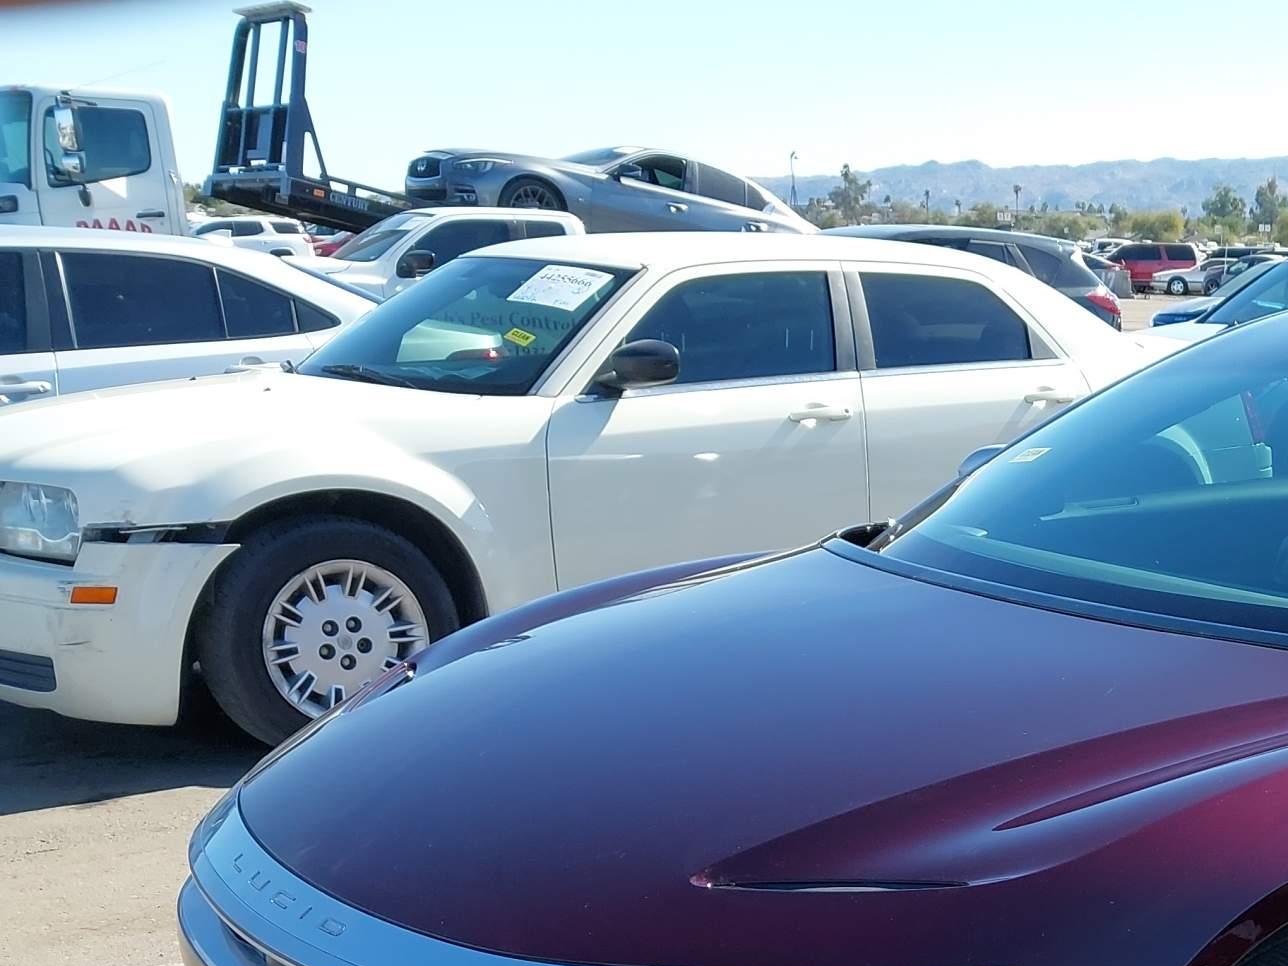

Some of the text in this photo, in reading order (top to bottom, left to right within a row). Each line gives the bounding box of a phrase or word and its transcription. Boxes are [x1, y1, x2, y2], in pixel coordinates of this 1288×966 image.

[329, 191, 369, 212] CENTURY
[470, 311, 504, 327] Pest
[509, 311, 577, 331] Control
[233, 854, 347, 937] LUCID
